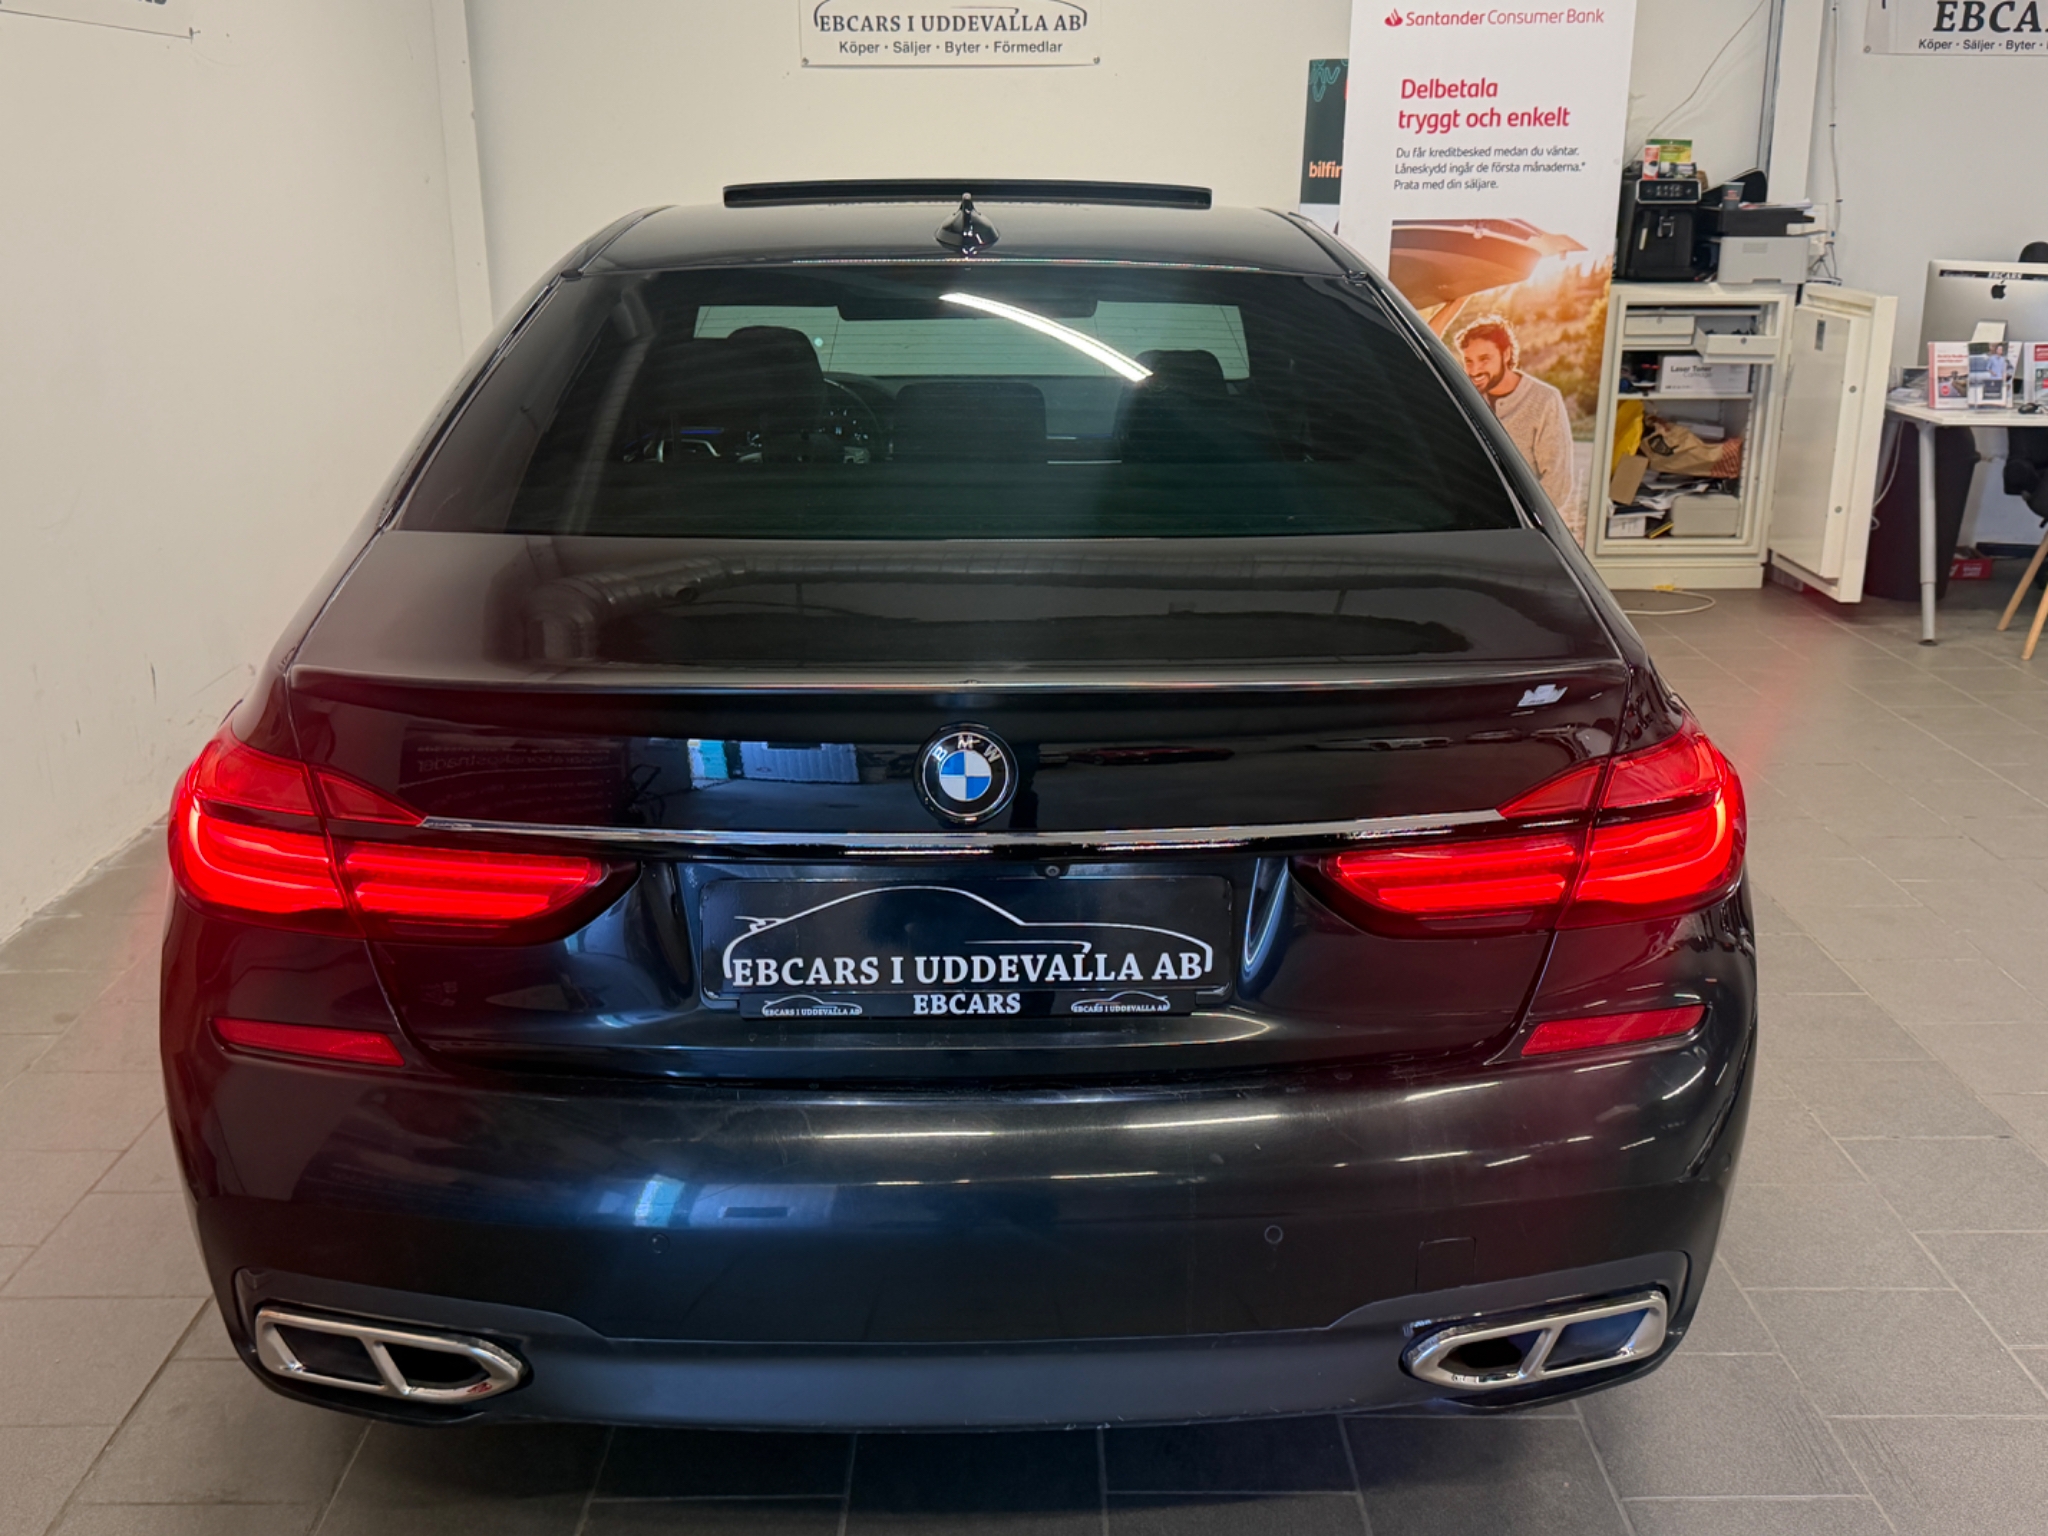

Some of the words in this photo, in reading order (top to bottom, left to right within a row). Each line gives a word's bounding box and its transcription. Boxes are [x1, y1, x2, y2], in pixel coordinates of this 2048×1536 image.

[819, 15, 901, 32] EBCARS
[907, 15, 915, 31] I
[921, 14, 1049, 32] UDDEVALLA
[1053, 14, 1082, 31] AB
[1405, 10, 1486, 27] Santander
[1487, 9, 1565, 25] Consumer
[1566, 8, 1605, 24] Bank
[1932, 0, 2048, 33] EBCA
[839, 41, 880, 56] Köper
[893, 40, 931, 55] Säljer
[945, 41, 981, 55] Byter
[993, 40, 1063, 54] Förmedlar
[1918, 38, 1953, 52] Köper
[1962, 39, 1995, 52] Säljer
[2005, 40, 2036, 52] Byter
[1400, 77, 1499, 100] Delbetala
[1398, 108, 1461, 134] tryggt
[1466, 107, 1501, 127] och
[1507, 106, 1571, 128] enkelt
[1396, 147, 1411, 158] Du
[1412, 146, 1427, 158] får
[1429, 146, 1492, 158] kreditbesked
[1493, 146, 1528, 157] medan
[1530, 145, 1544, 157] du
[1546, 144, 1580, 156] väntar.
[1394, 162, 1448, 177] Låneskydd
[1449, 161, 1475, 176] ingår
[1476, 162, 1490, 173] de
[1491, 161, 1521, 173] första
[1393, 179, 1420, 190] Prata
[1422, 178, 1445, 190] med
[1446, 178, 1462, 190] din
[1463, 178, 1499, 192] säljare.
[931, 734, 1001, 763] BMW
[732, 956, 879, 987] EBCARS
[891, 956, 904, 985] I
[916, 950, 1143, 984] UDDEVALLA
[1152, 952, 1203, 981] AB
[912, 992, 1022, 1016] EBCARS
